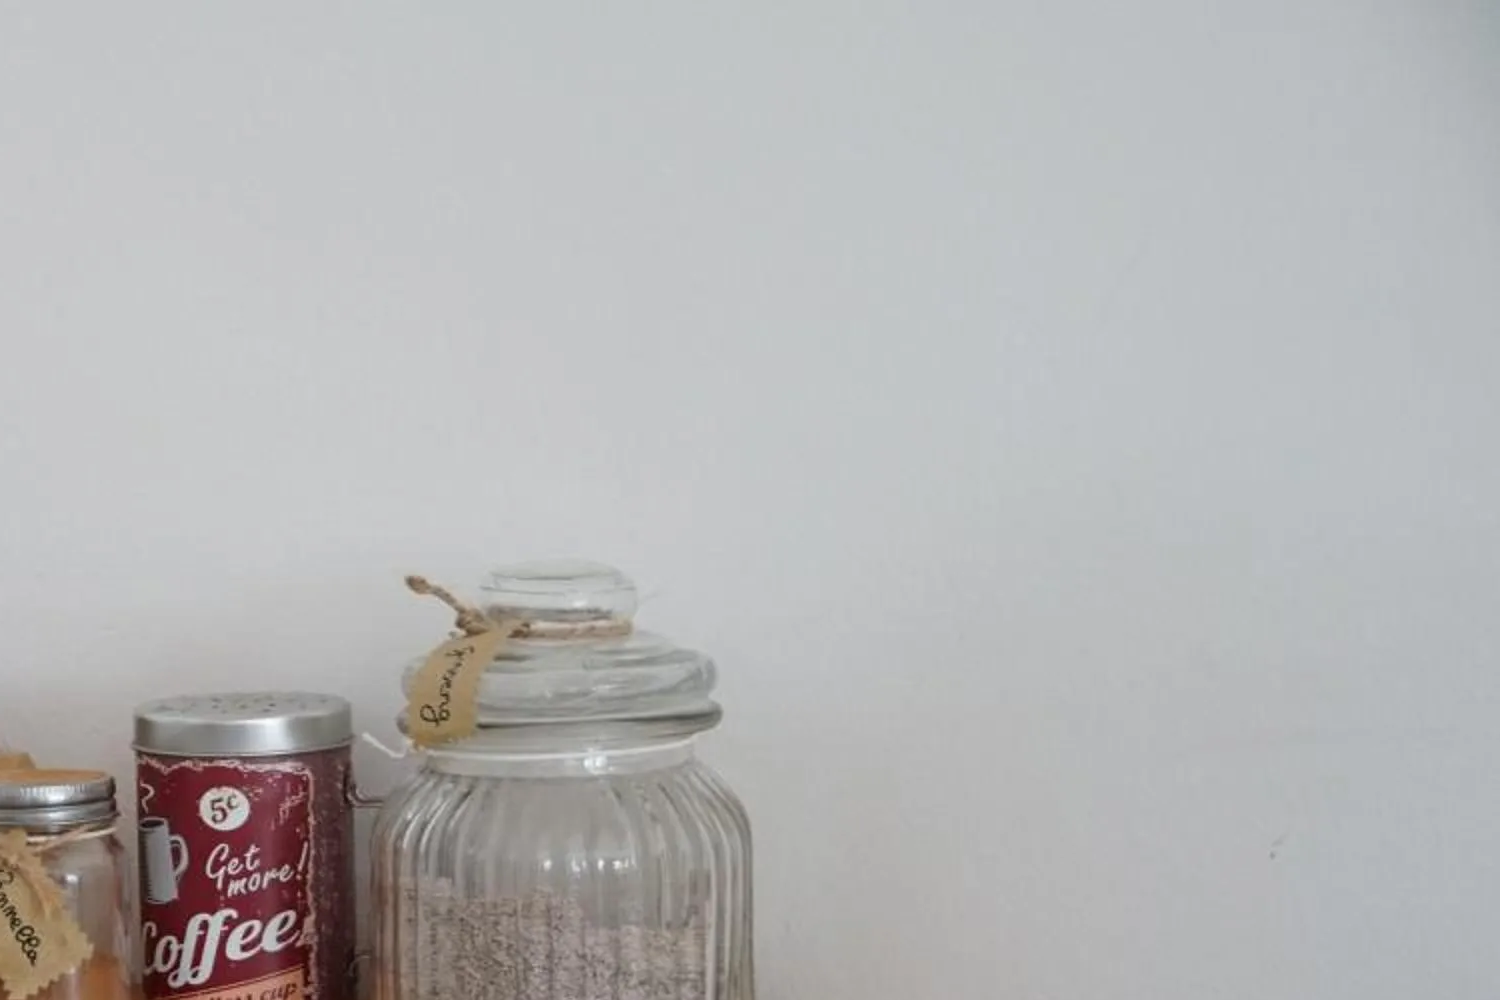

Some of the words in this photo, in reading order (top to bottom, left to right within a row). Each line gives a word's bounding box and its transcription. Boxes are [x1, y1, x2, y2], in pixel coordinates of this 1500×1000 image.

[205, 843, 261, 890] Get
[227, 841, 309, 898] more!
[141, 907, 301, 989] Coffee
